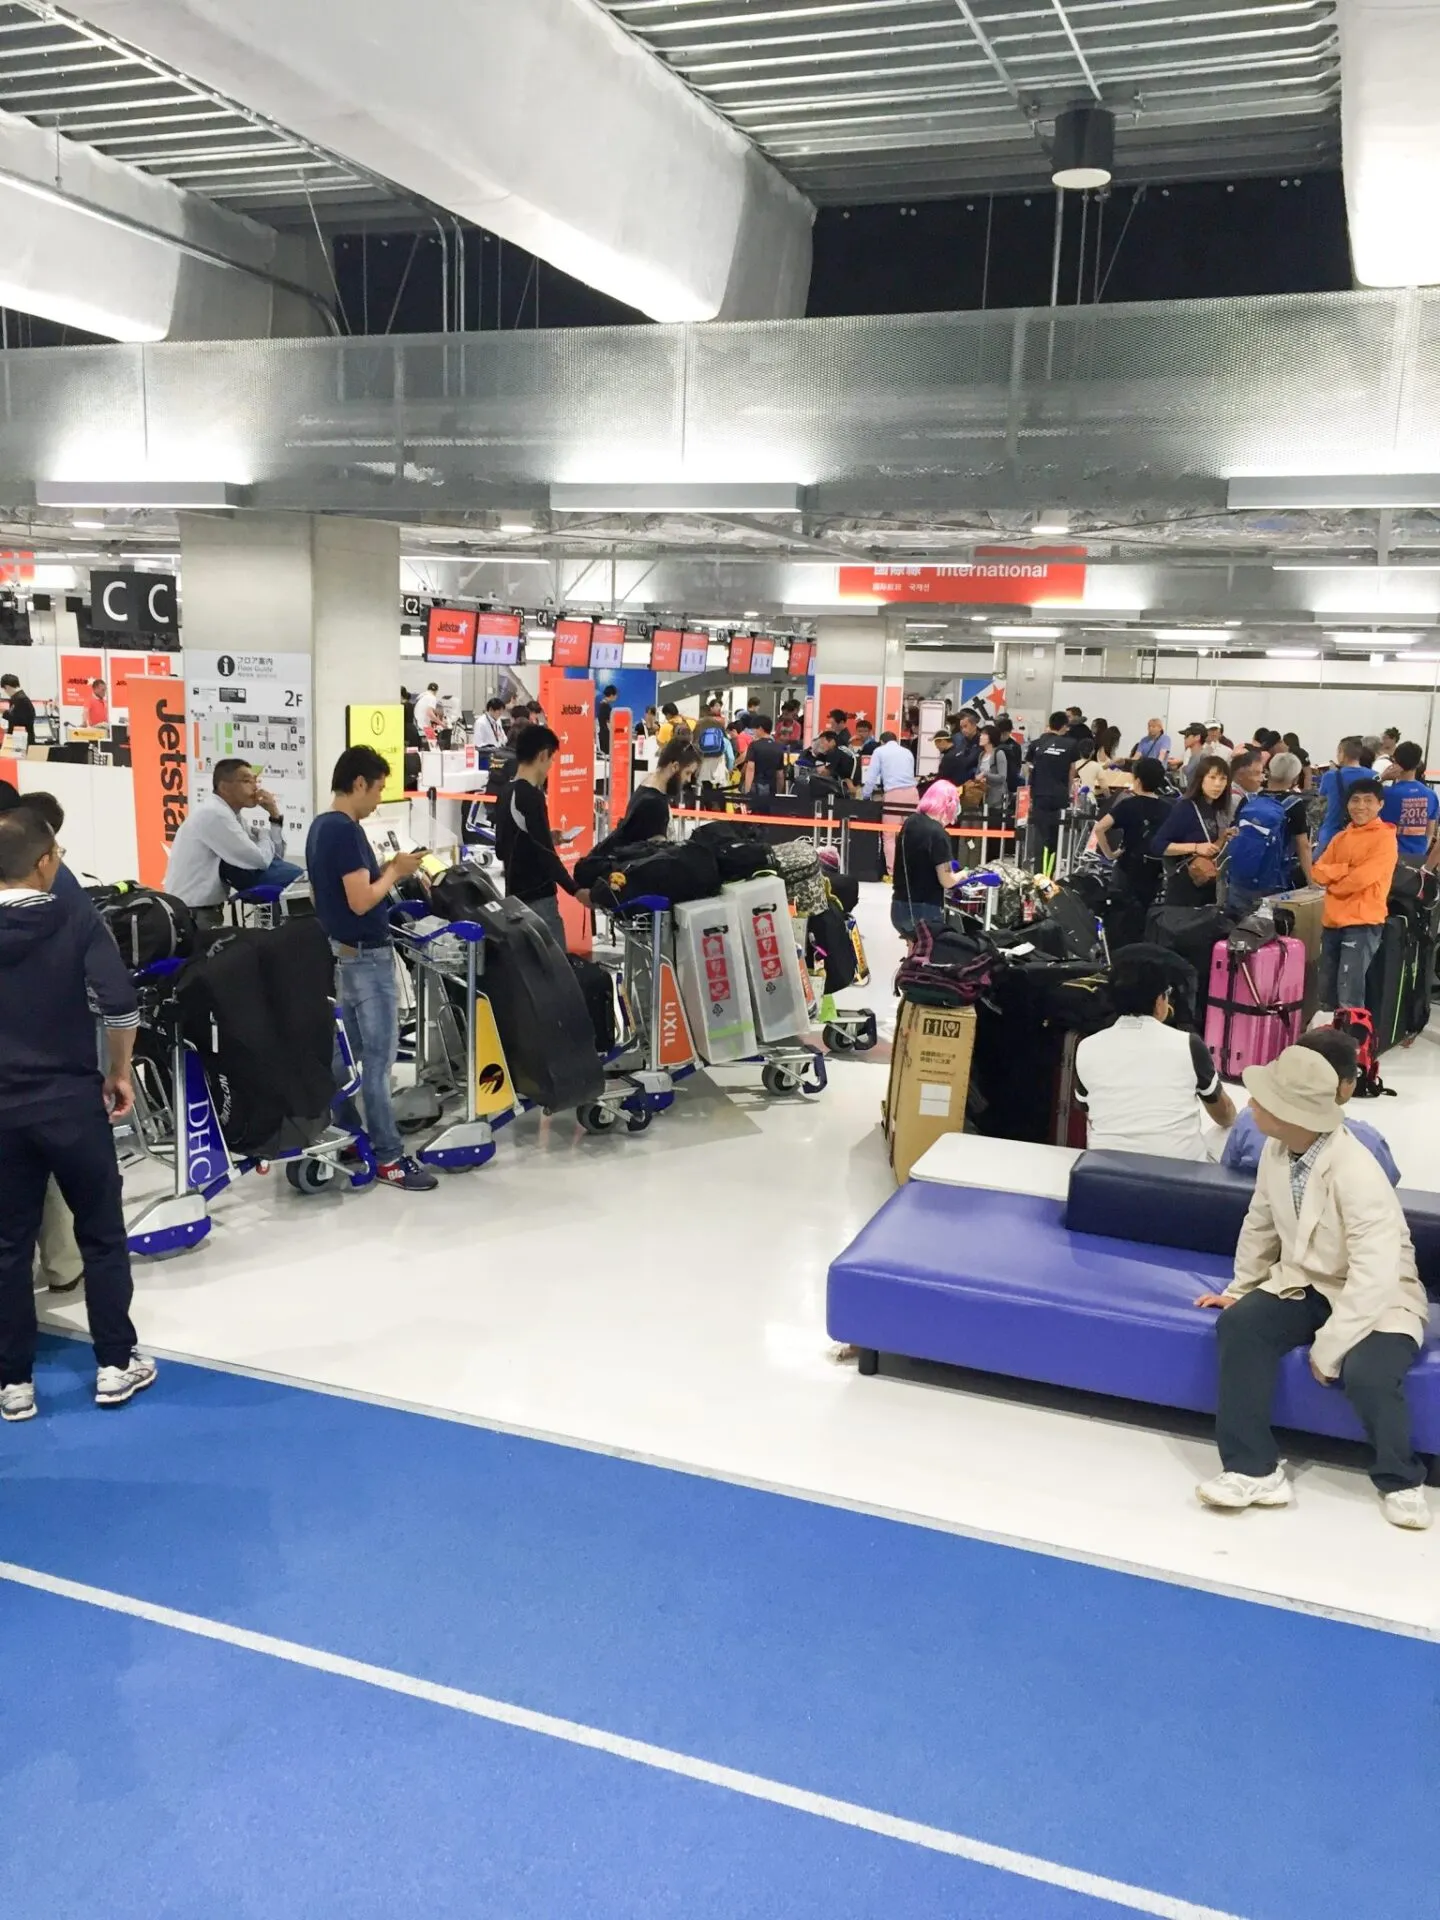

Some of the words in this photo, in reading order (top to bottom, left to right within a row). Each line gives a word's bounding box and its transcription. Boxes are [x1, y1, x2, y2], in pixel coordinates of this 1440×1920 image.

[936, 563, 1048, 578] International
[102, 581, 128, 622] C
[148, 584, 170, 623] C
[405, 598, 419, 614] C2
[537, 612, 548, 625] C4
[284, 690, 303, 707] 2F
[1401, 808, 1427, 818] 2016
[664, 1002, 676, 1047] LIXIL
[188, 1097, 212, 1184] DHC
